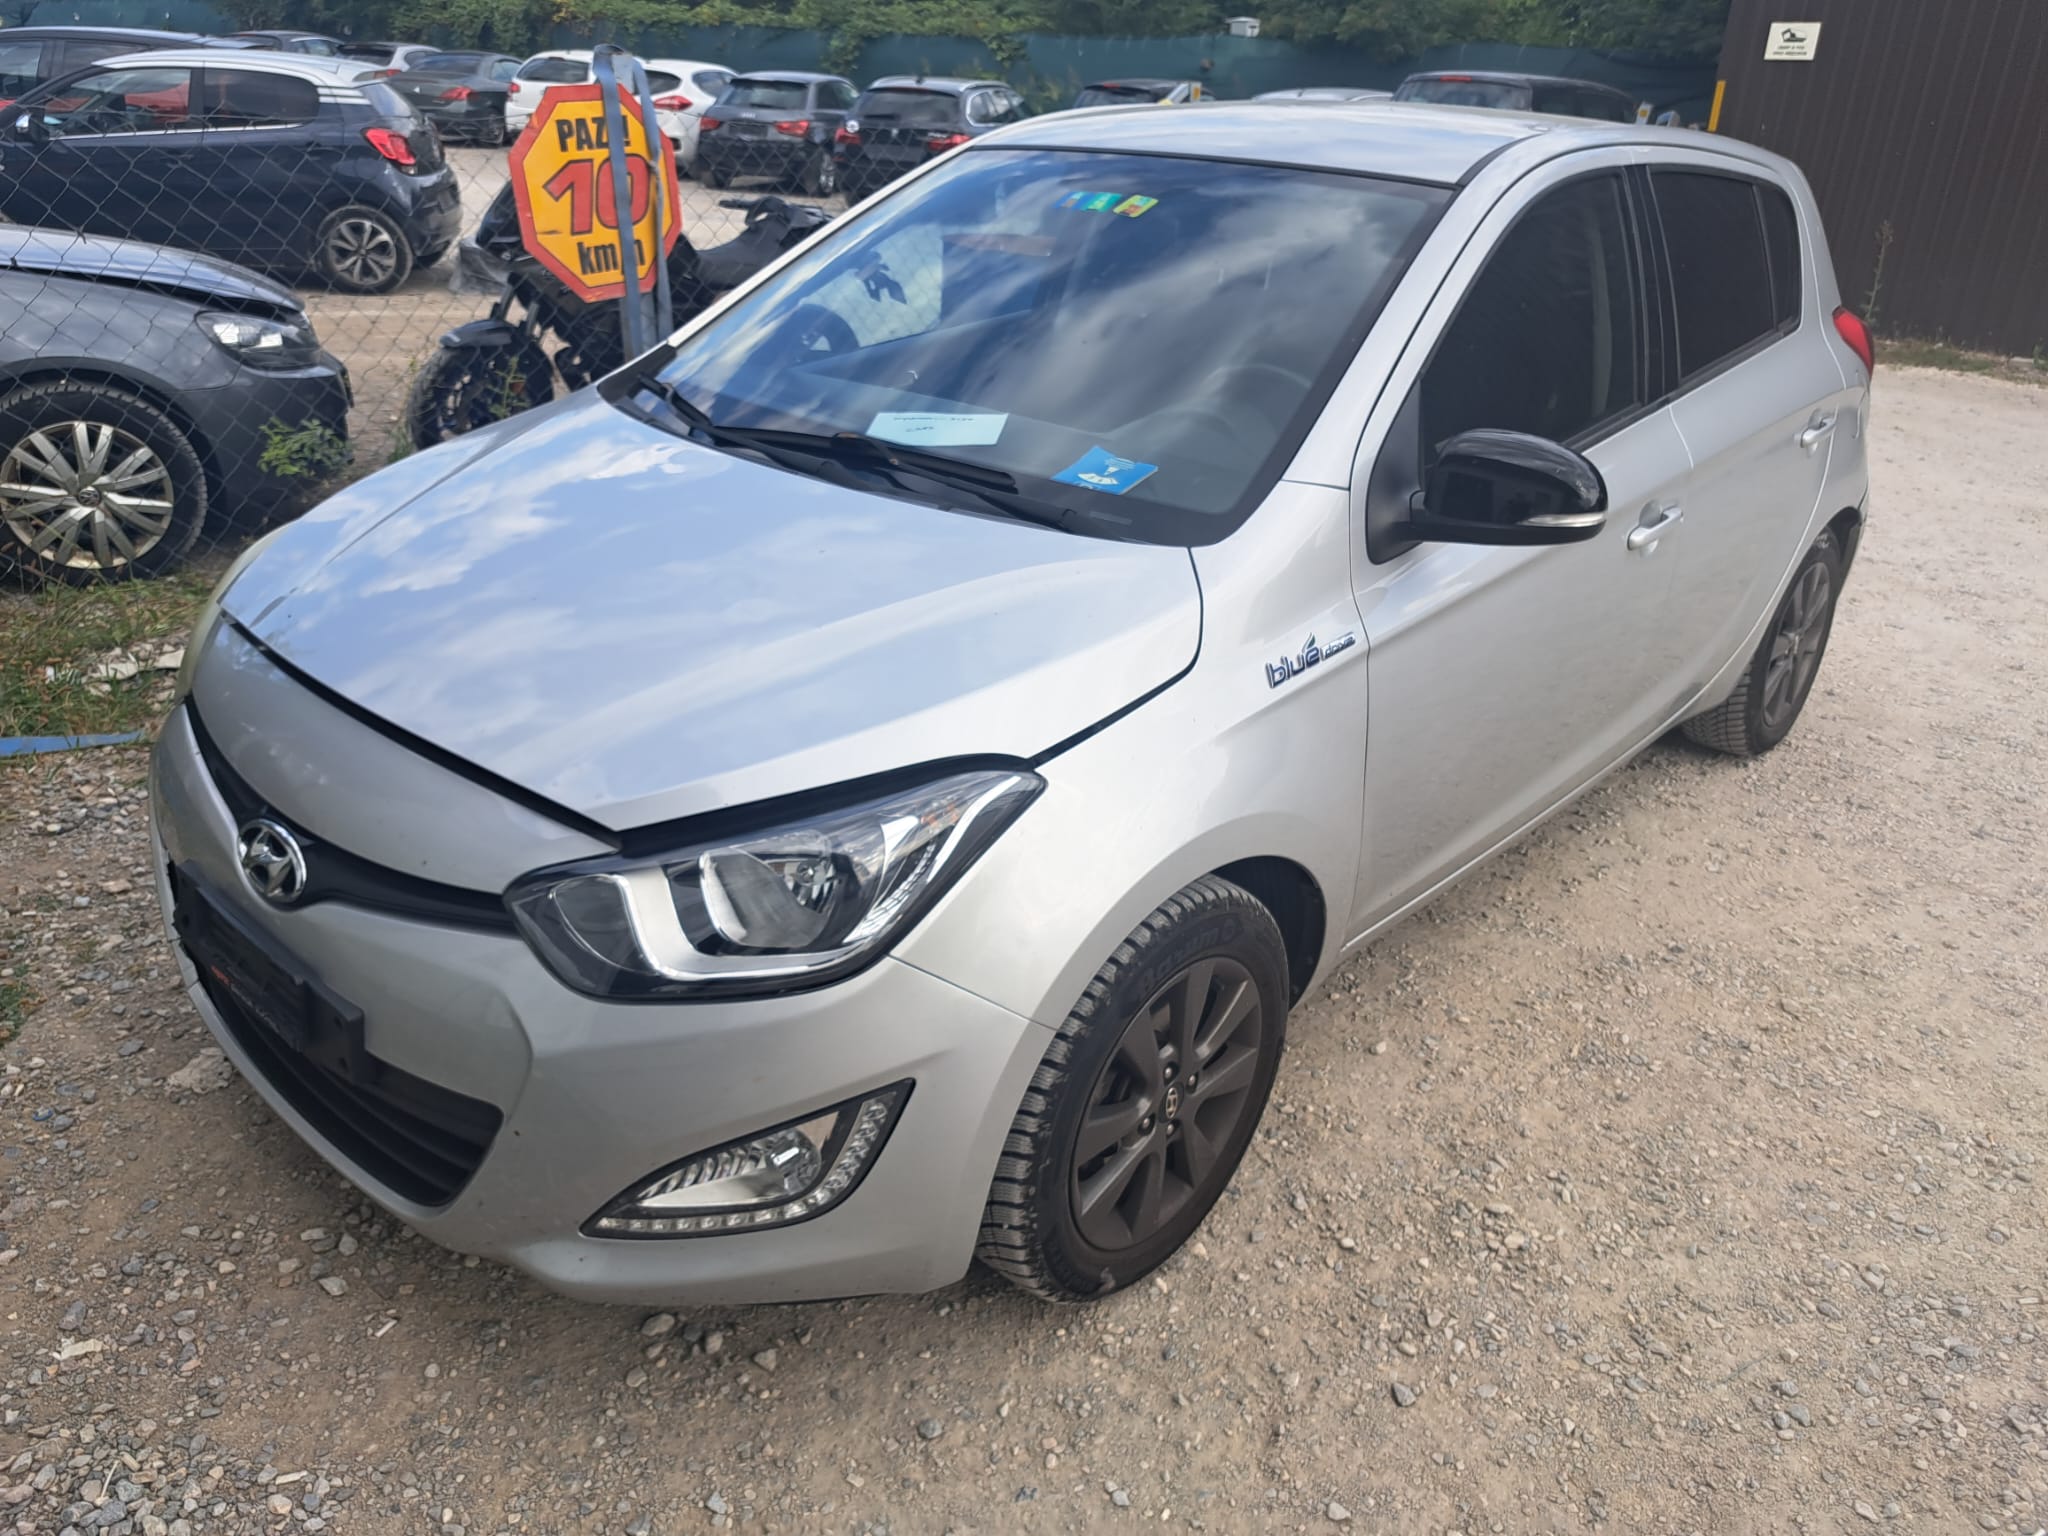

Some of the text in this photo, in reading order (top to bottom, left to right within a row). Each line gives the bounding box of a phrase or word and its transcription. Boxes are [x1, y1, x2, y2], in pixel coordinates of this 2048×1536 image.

[556, 115, 632, 152] PAZ!
[542, 153, 650, 236] 10
[577, 239, 646, 276] km
[1265, 645, 1320, 689] blue
